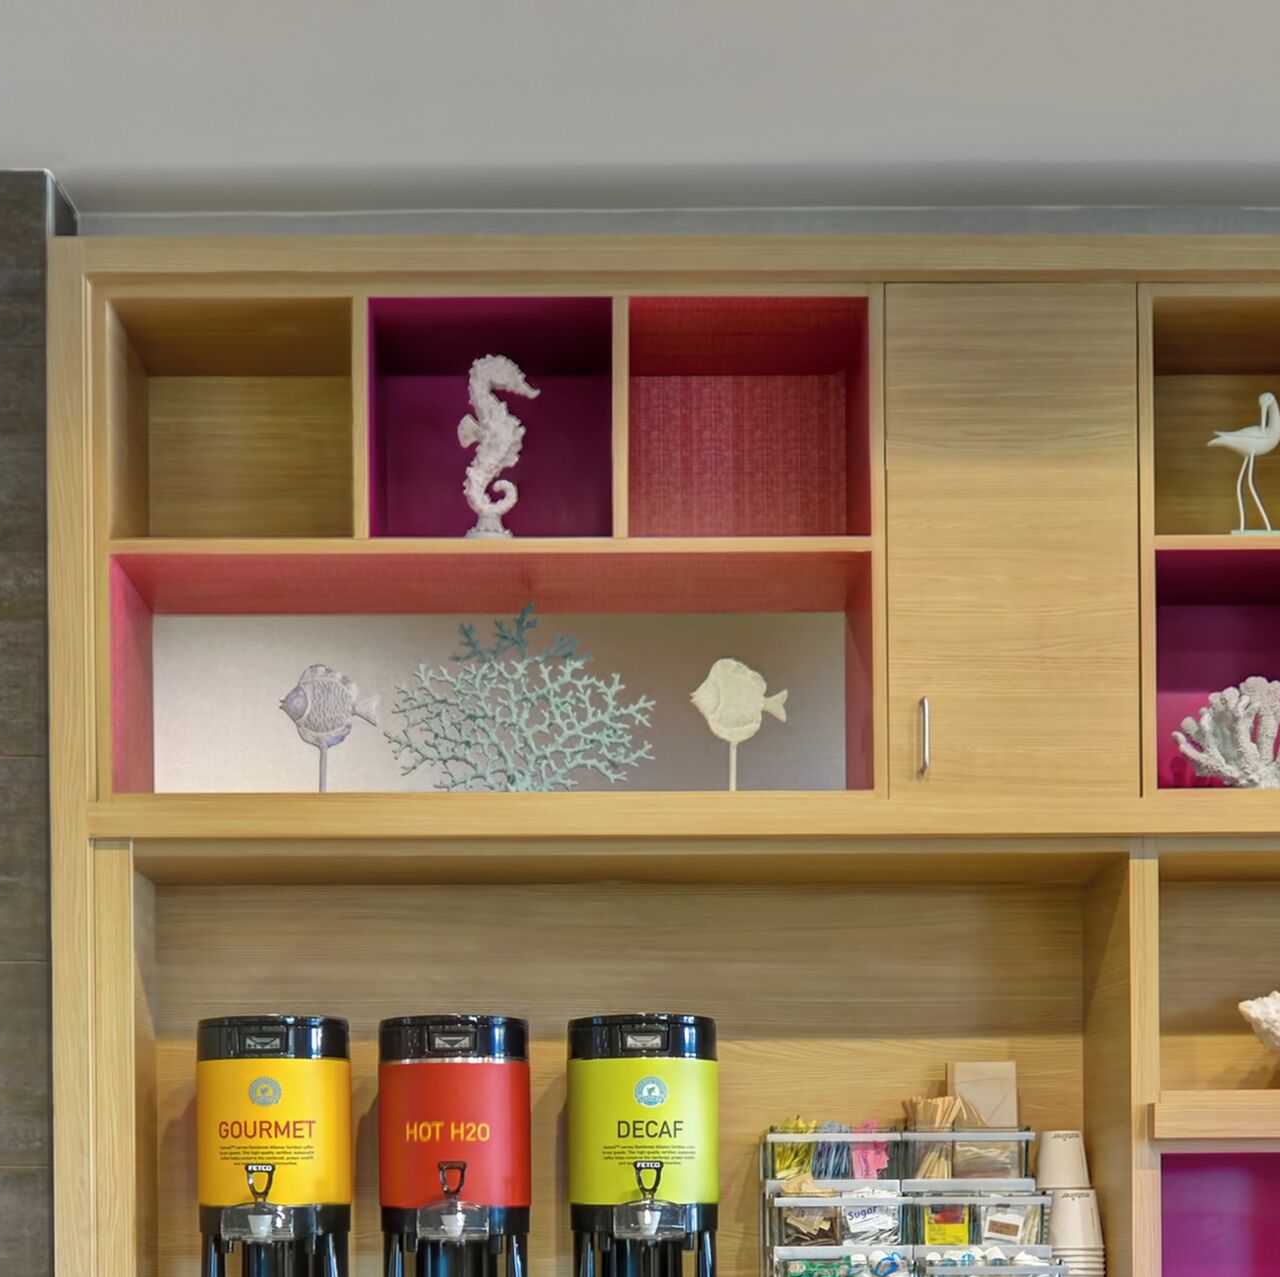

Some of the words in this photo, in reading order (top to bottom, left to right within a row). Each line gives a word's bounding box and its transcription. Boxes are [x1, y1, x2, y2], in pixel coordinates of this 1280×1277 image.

[218, 1120, 316, 1139] GOURMET
[405, 1121, 444, 1142] HOT
[617, 1120, 684, 1138] DECAF
[848, 1206, 878, 1220] Sugar
